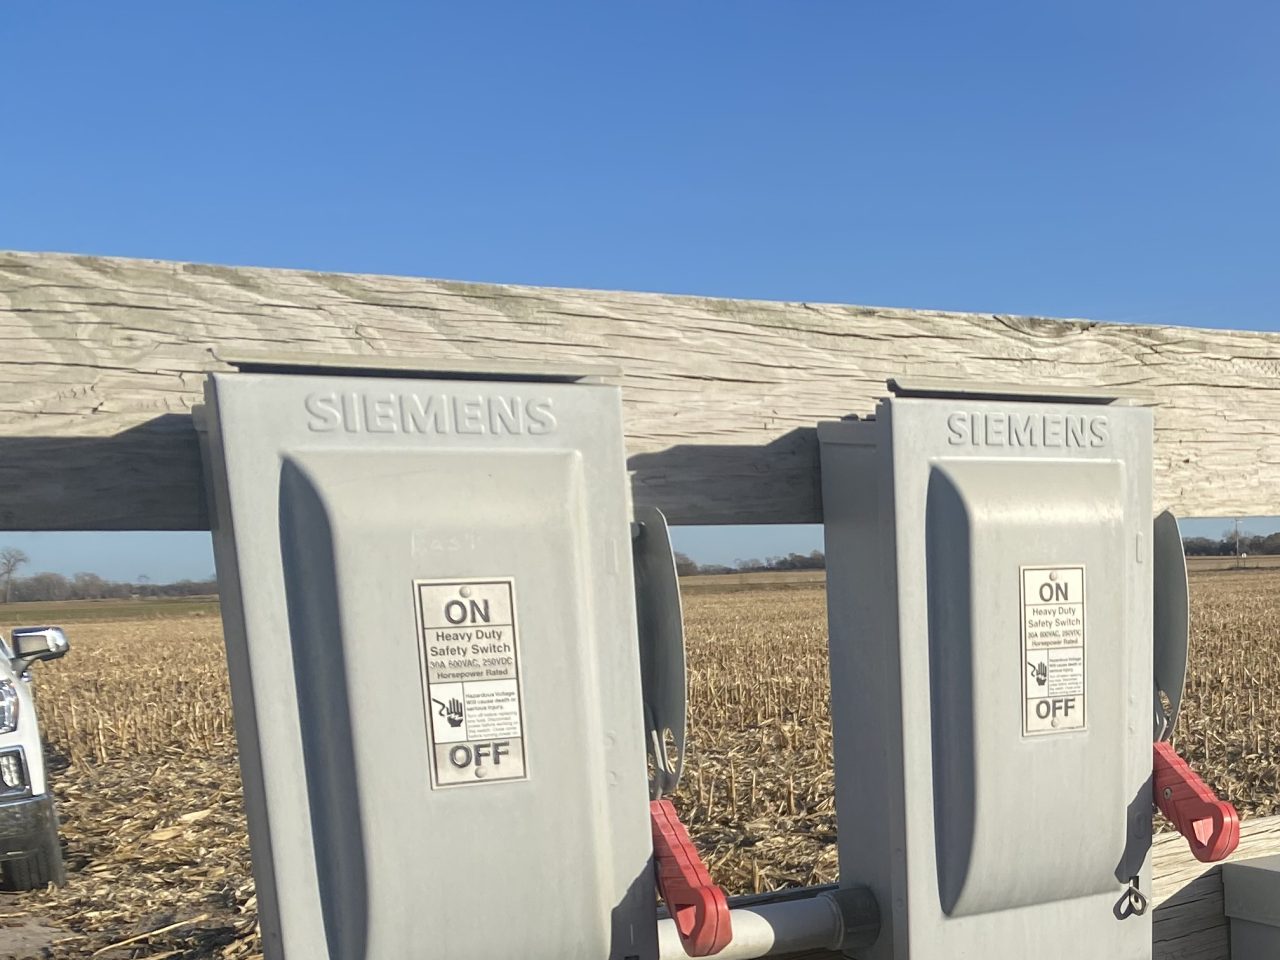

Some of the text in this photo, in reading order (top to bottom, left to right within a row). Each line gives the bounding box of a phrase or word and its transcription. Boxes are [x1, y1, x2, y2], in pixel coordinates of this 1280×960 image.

[304, 391, 559, 436] SIEMENS
[947, 410, 1111, 448] SIEMENS
[1039, 582, 1069, 603] ON
[444, 598, 491, 625] ON
[1032, 606, 1076, 617] Heavy Duty
[1028, 617, 1081, 629] Safety Switch
[435, 628, 503, 643] Heavy Duty
[430, 642, 511, 658] Safety Switch
[437, 668, 509, 680] Horsepower Rated
[1036, 698, 1076, 720] OFF
[449, 741, 510, 769] OFF
